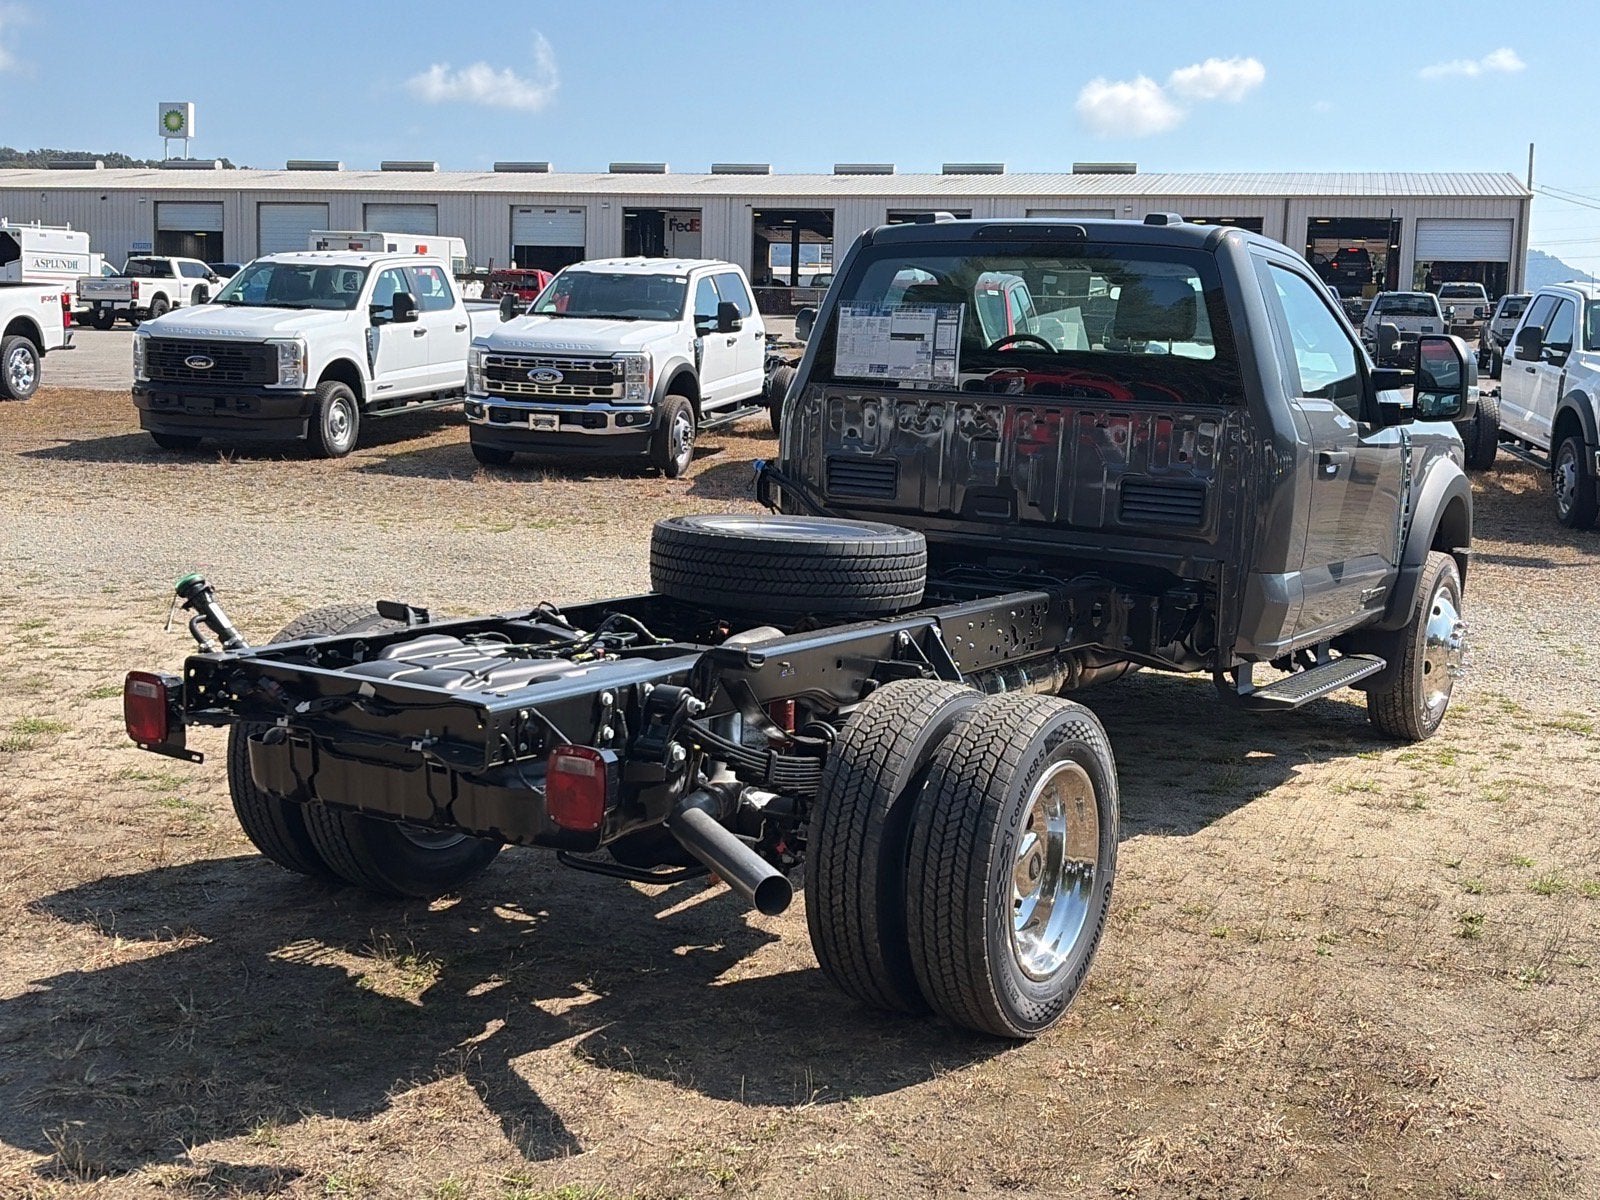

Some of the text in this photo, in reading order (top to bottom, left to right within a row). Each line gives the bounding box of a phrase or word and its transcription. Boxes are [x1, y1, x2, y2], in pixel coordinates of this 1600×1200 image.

[668, 217, 700, 232] FedE
[34, 259, 78, 270] ASPLUNDH
[1009, 748, 1045, 828] Conti HSR 5
[1074, 880, 1112, 987] Continental
